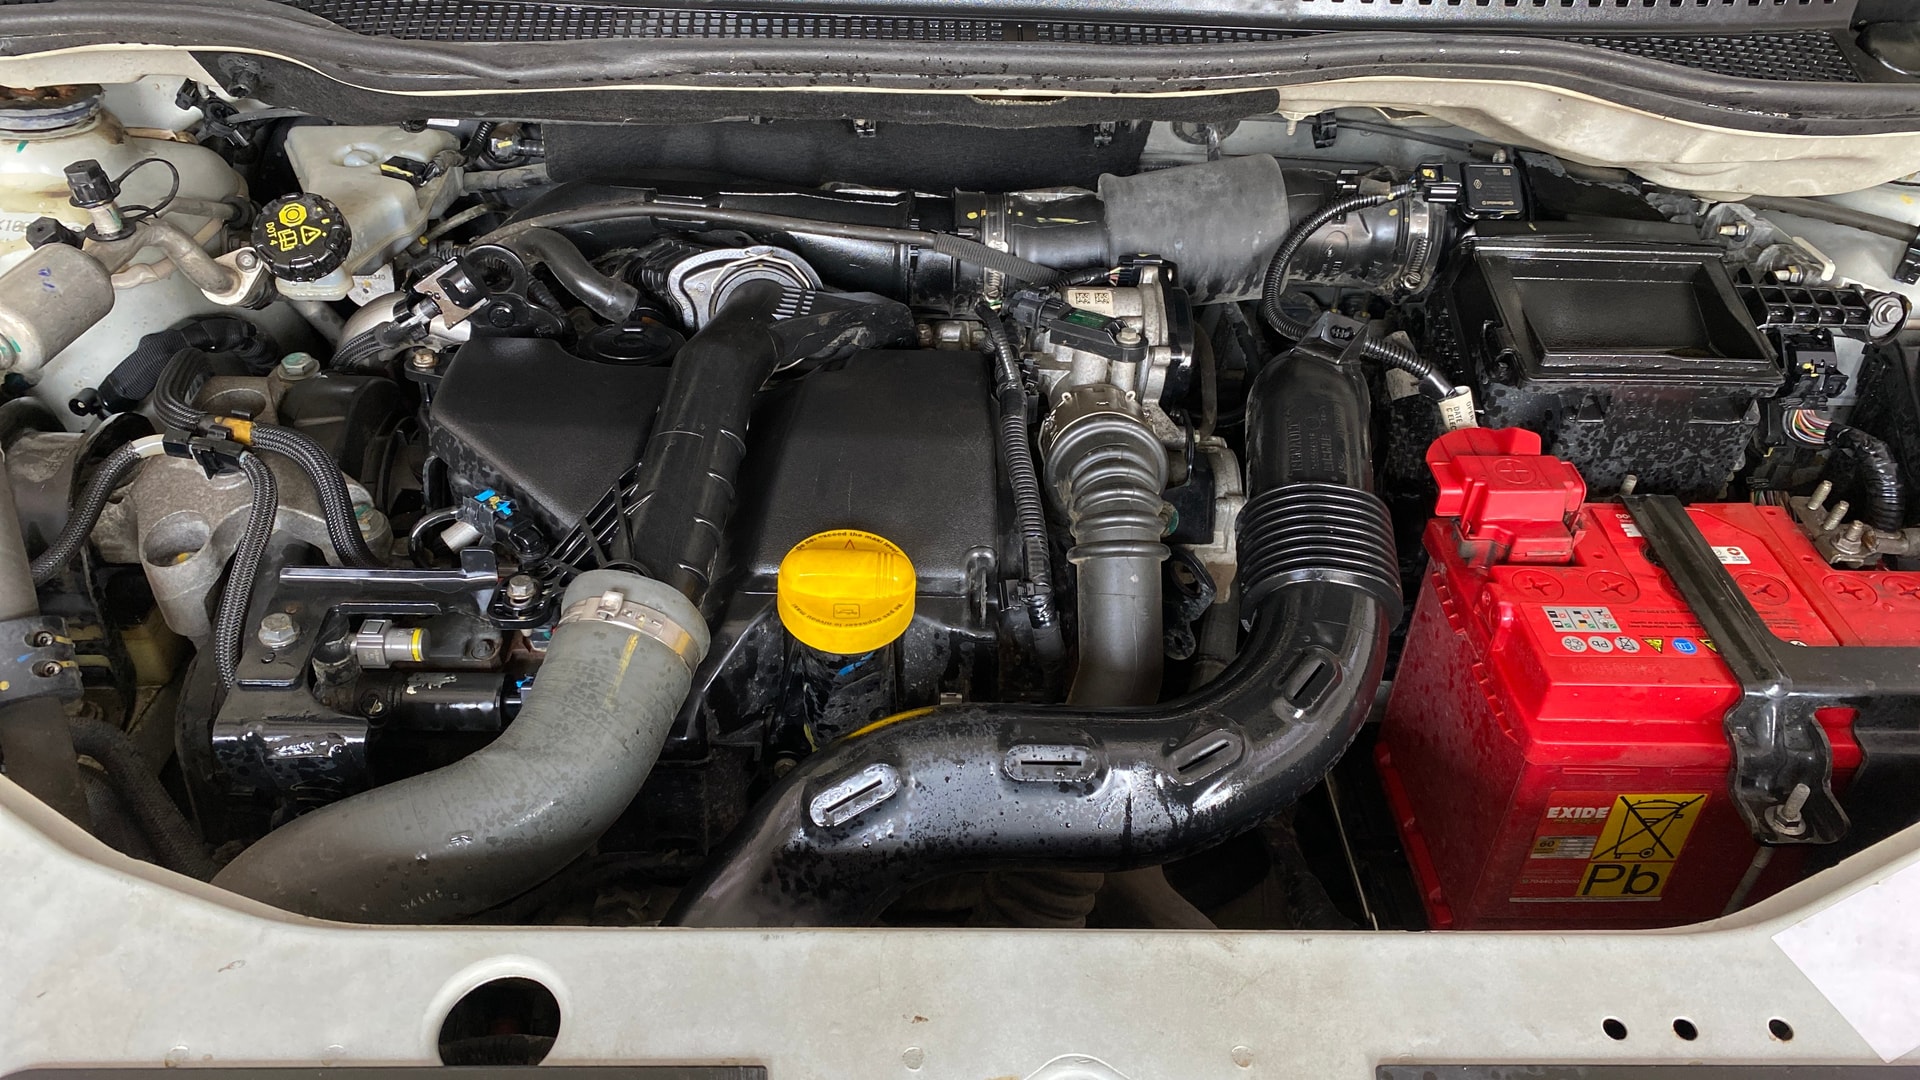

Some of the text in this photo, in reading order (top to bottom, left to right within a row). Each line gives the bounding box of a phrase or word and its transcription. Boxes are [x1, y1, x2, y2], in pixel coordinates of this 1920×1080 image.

[265, 221, 277, 238] DOT
[1453, 406, 1464, 424] DATE
[1591, 640, 1608, 648] Pb
[1547, 807, 1610, 818] EXIDE
[1539, 840, 1555, 848] 60
[1582, 864, 1660, 895] Pb
